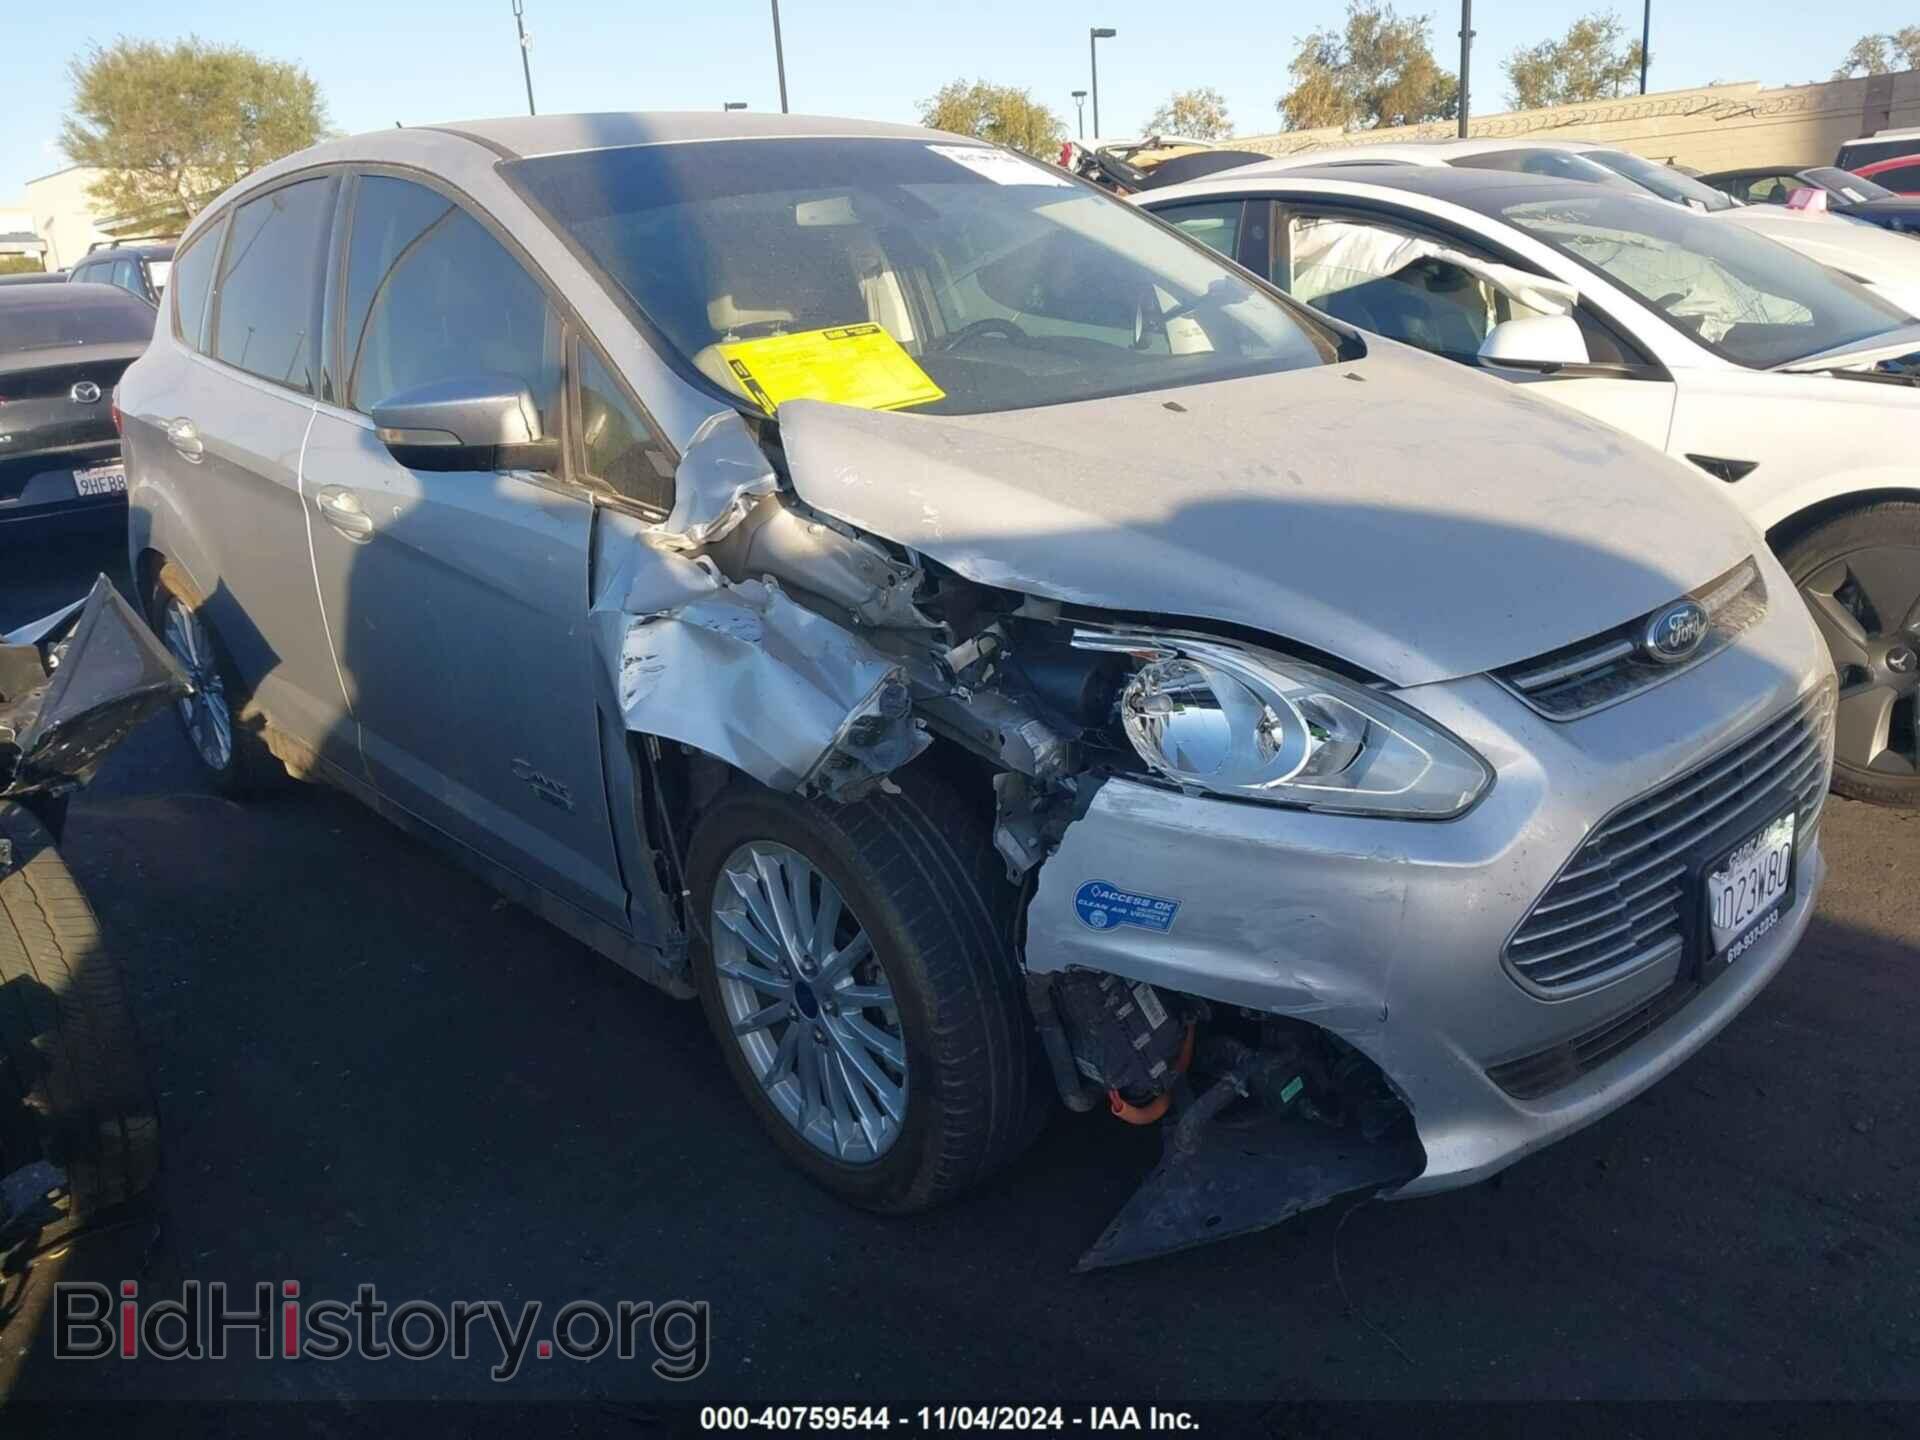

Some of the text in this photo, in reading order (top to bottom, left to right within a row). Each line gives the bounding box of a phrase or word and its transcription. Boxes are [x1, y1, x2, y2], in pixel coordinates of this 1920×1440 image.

[1669, 609, 1706, 647] Ford
[1078, 899, 1109, 910] CLEAN
[1110, 906, 1128, 914] AIR
[1100, 890, 1175, 911] ACCESS OK
